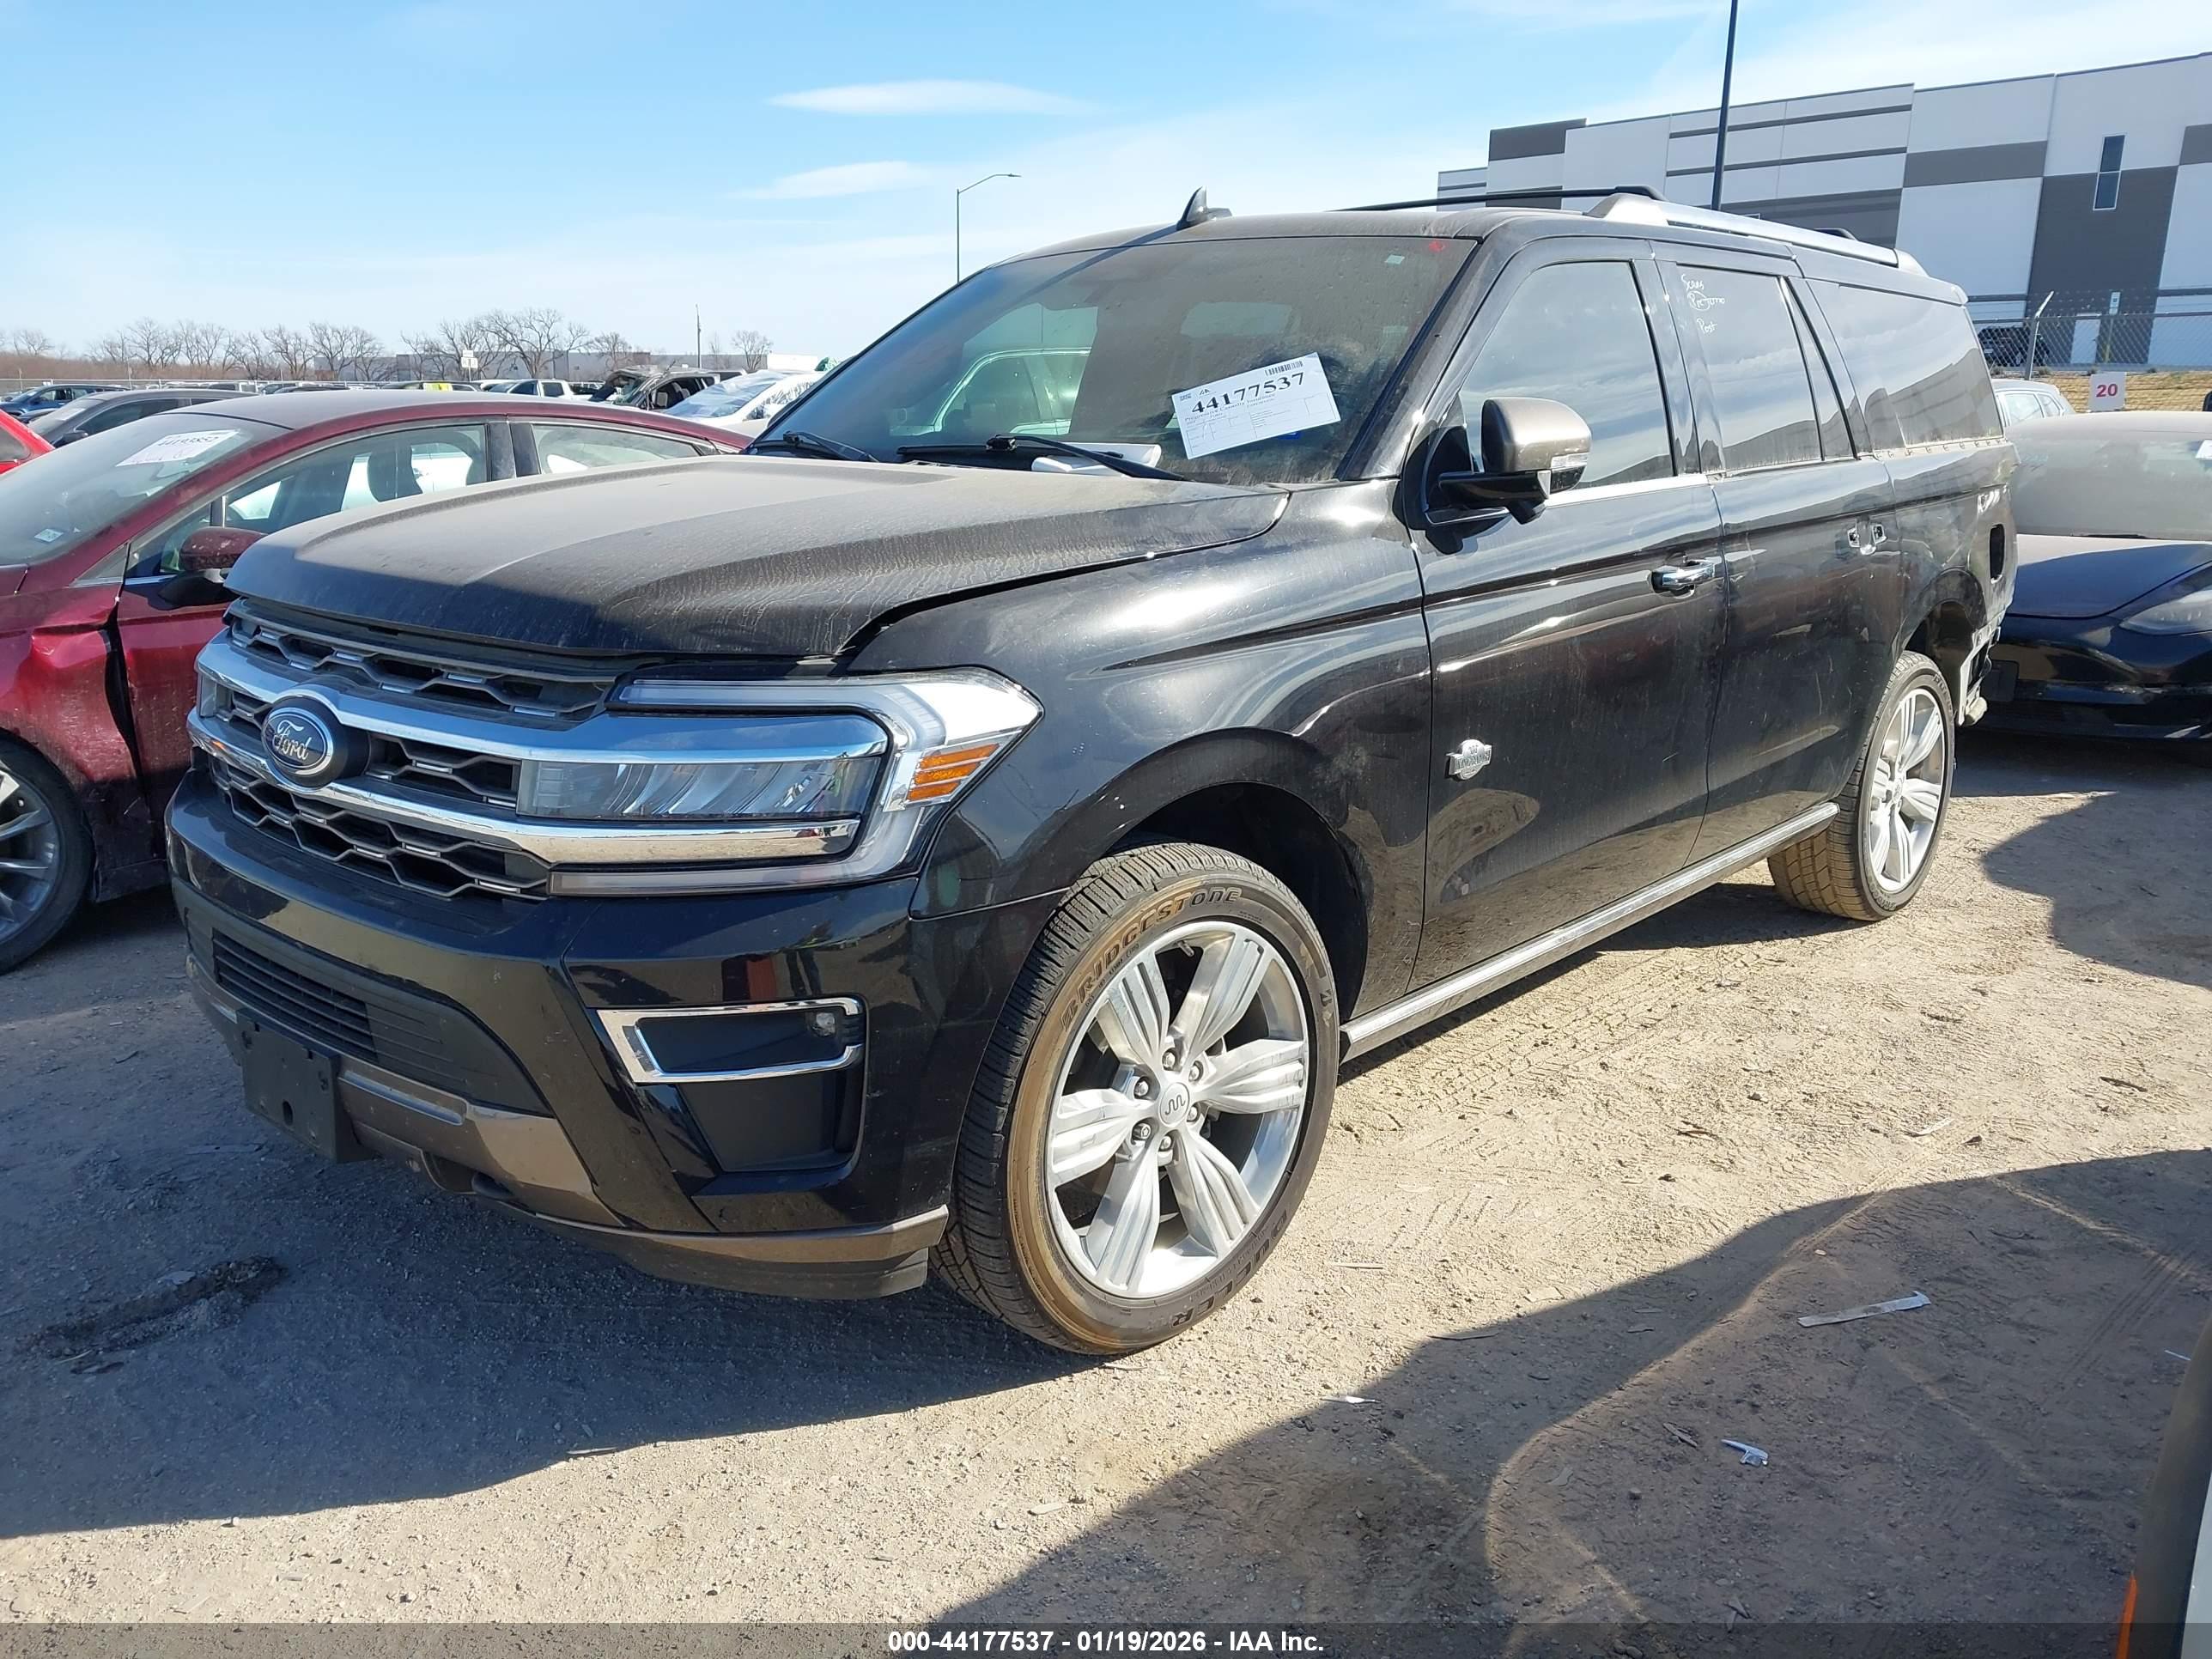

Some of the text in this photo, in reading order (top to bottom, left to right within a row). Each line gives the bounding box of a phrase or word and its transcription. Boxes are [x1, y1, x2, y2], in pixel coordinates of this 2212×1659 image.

[1191, 372, 1304, 414] 44177537
[2096, 383, 2118, 398] 20
[272, 720, 312, 760] Ford
[1060, 887, 1242, 1030] BRIDGESTONE
